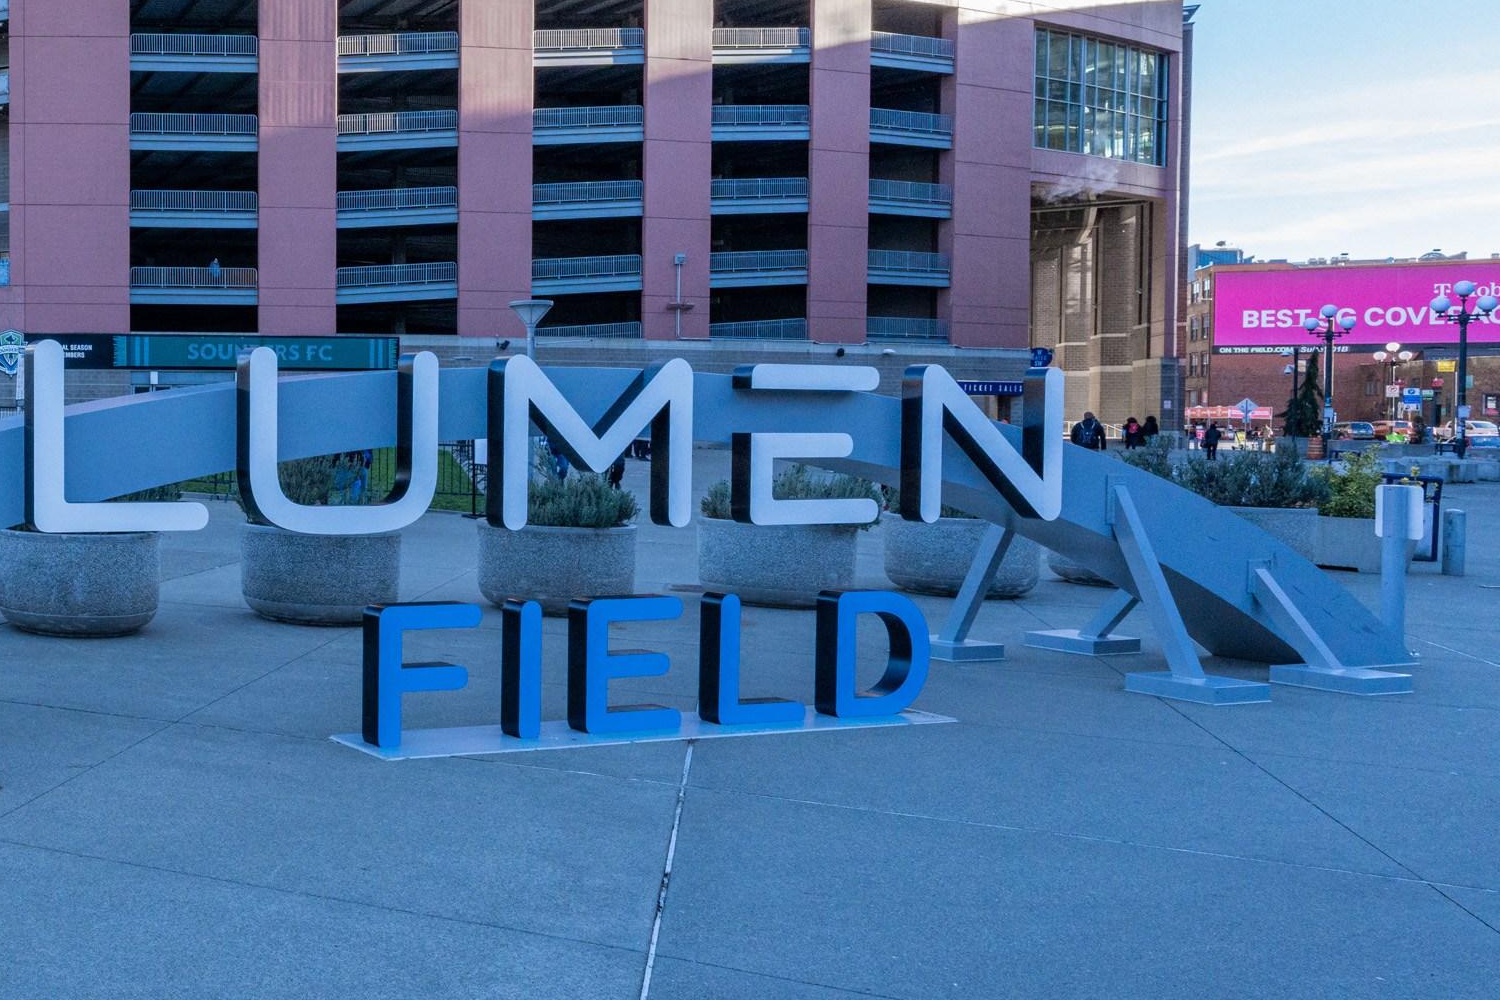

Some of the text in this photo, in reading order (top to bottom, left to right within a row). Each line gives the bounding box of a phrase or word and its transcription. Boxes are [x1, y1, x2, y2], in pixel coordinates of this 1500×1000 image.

[1243, 309, 1312, 329] BEST
[306, 344, 333, 361] FC
[963, 384, 1023, 393] TICKET SALES
[24, 339, 1063, 535] LUMEN
[363, 590, 931, 748] FIELD
